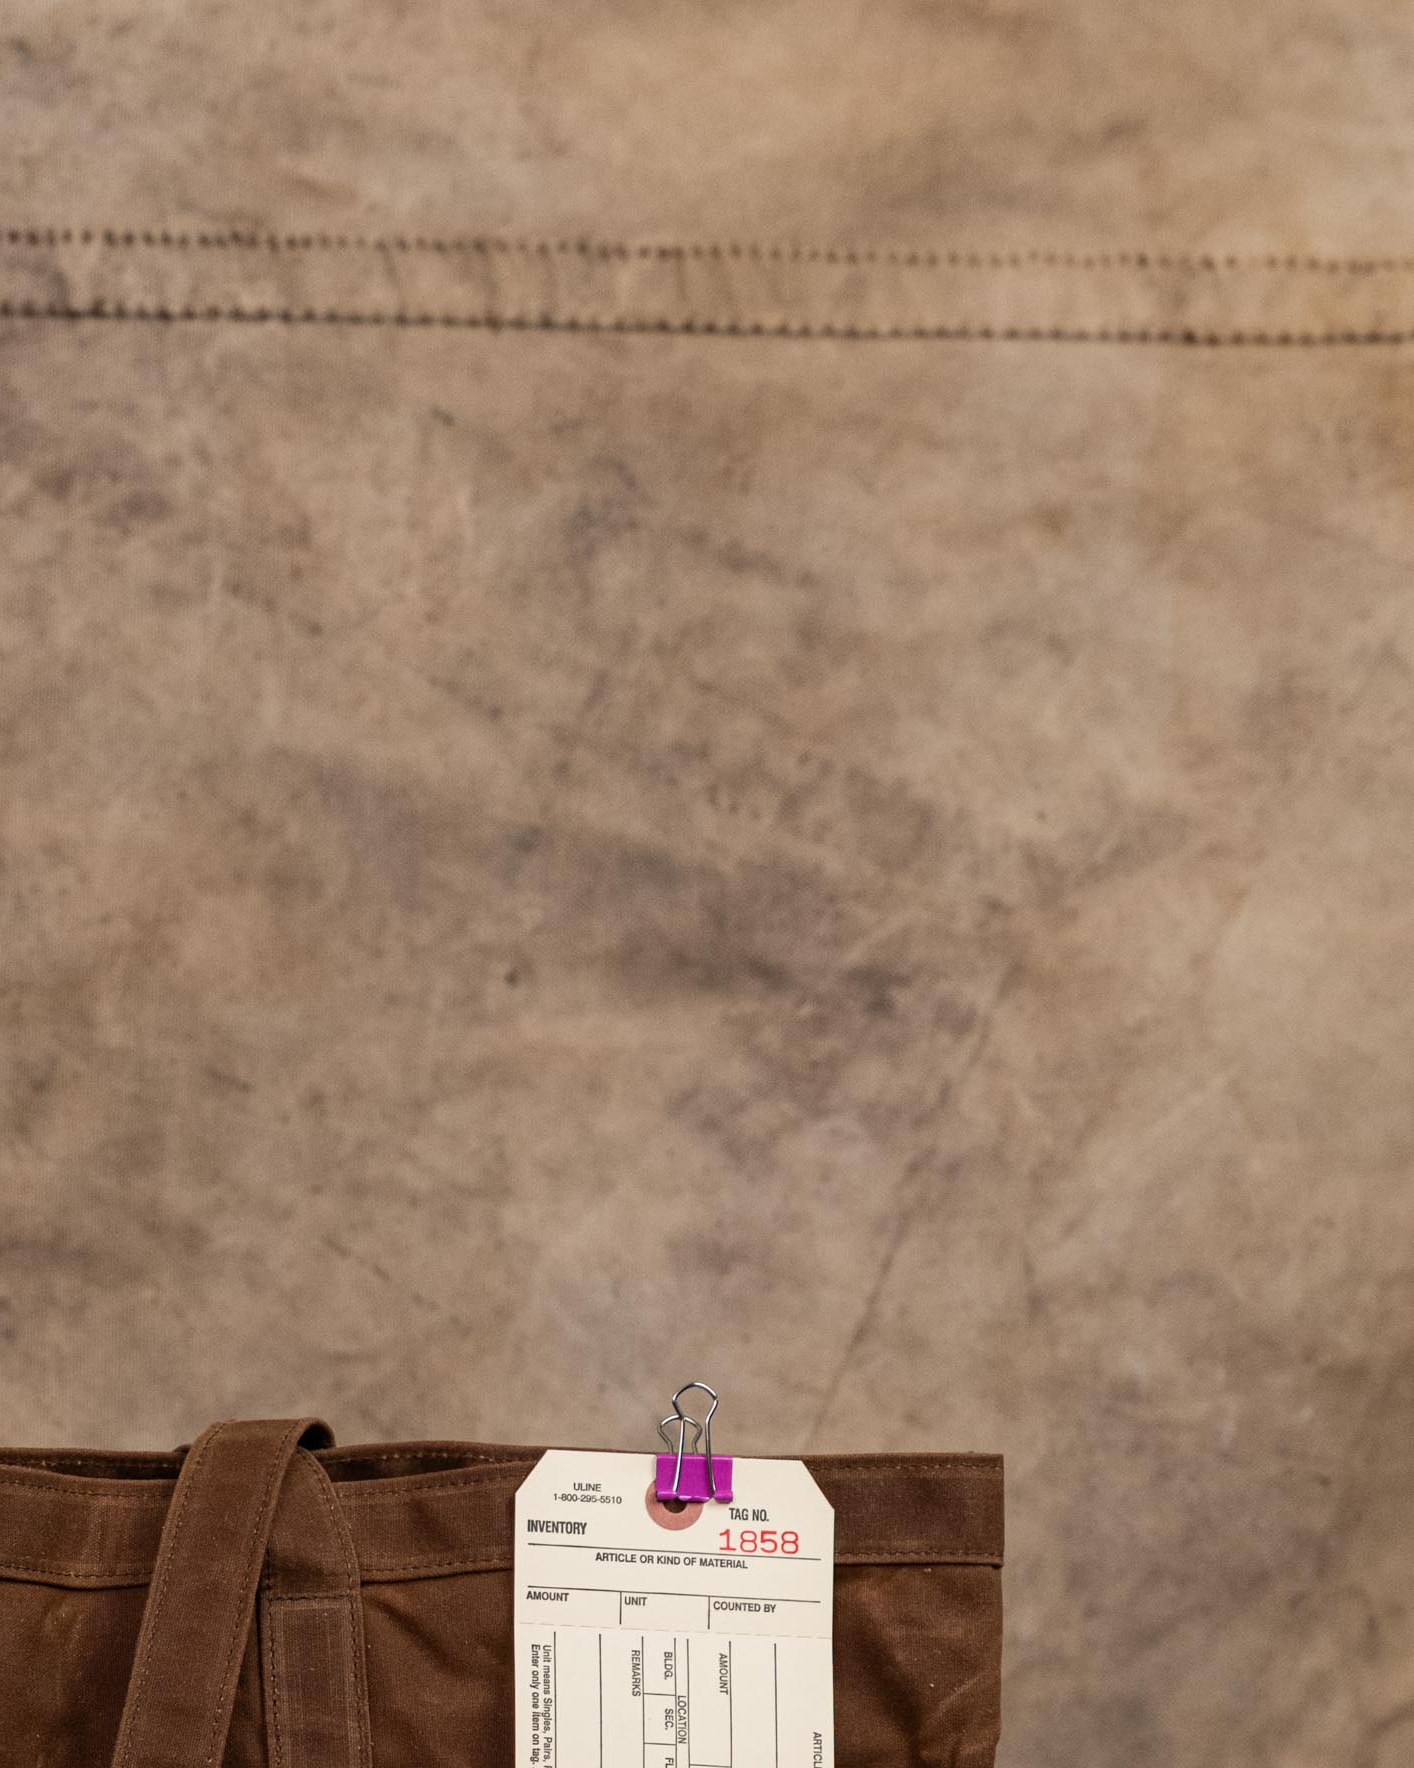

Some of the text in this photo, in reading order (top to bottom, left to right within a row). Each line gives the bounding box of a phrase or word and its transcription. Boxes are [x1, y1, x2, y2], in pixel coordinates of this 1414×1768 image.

[573, 1482, 601, 1492] ULINE
[553, 1493, 623, 1504] 1-800-295-5510
[729, 1507, 770, 1522] TAG NO.
[527, 1519, 587, 1535] INVENTORY
[719, 1528, 800, 1554] 1858
[595, 1552, 748, 1569] ARTICLE OR KIND OF MATERIAL
[526, 1591, 569, 1602] AMOUNT
[624, 1596, 647, 1606] UNIT
[713, 1601, 776, 1613] COUNTED BY
[531, 1644, 540, 1667] Enter
[542, 1645, 552, 1663] Unit
[632, 1649, 641, 1697] REMARKS
[664, 1651, 673, 1680] BLDG.
[719, 1653, 728, 1695] AMOUNT
[530, 1670, 540, 1688] only
[543, 1665, 552, 1695] means
[531, 1692, 539, 1709] one
[532, 1711, 540, 1731] item
[541, 1698, 552, 1734] Singles,
[665, 1708, 674, 1730] SEC.
[677, 1695, 687, 1744] LOCATION
[532, 1734, 539, 1745] on
[530, 1748, 540, 1765] tag.
